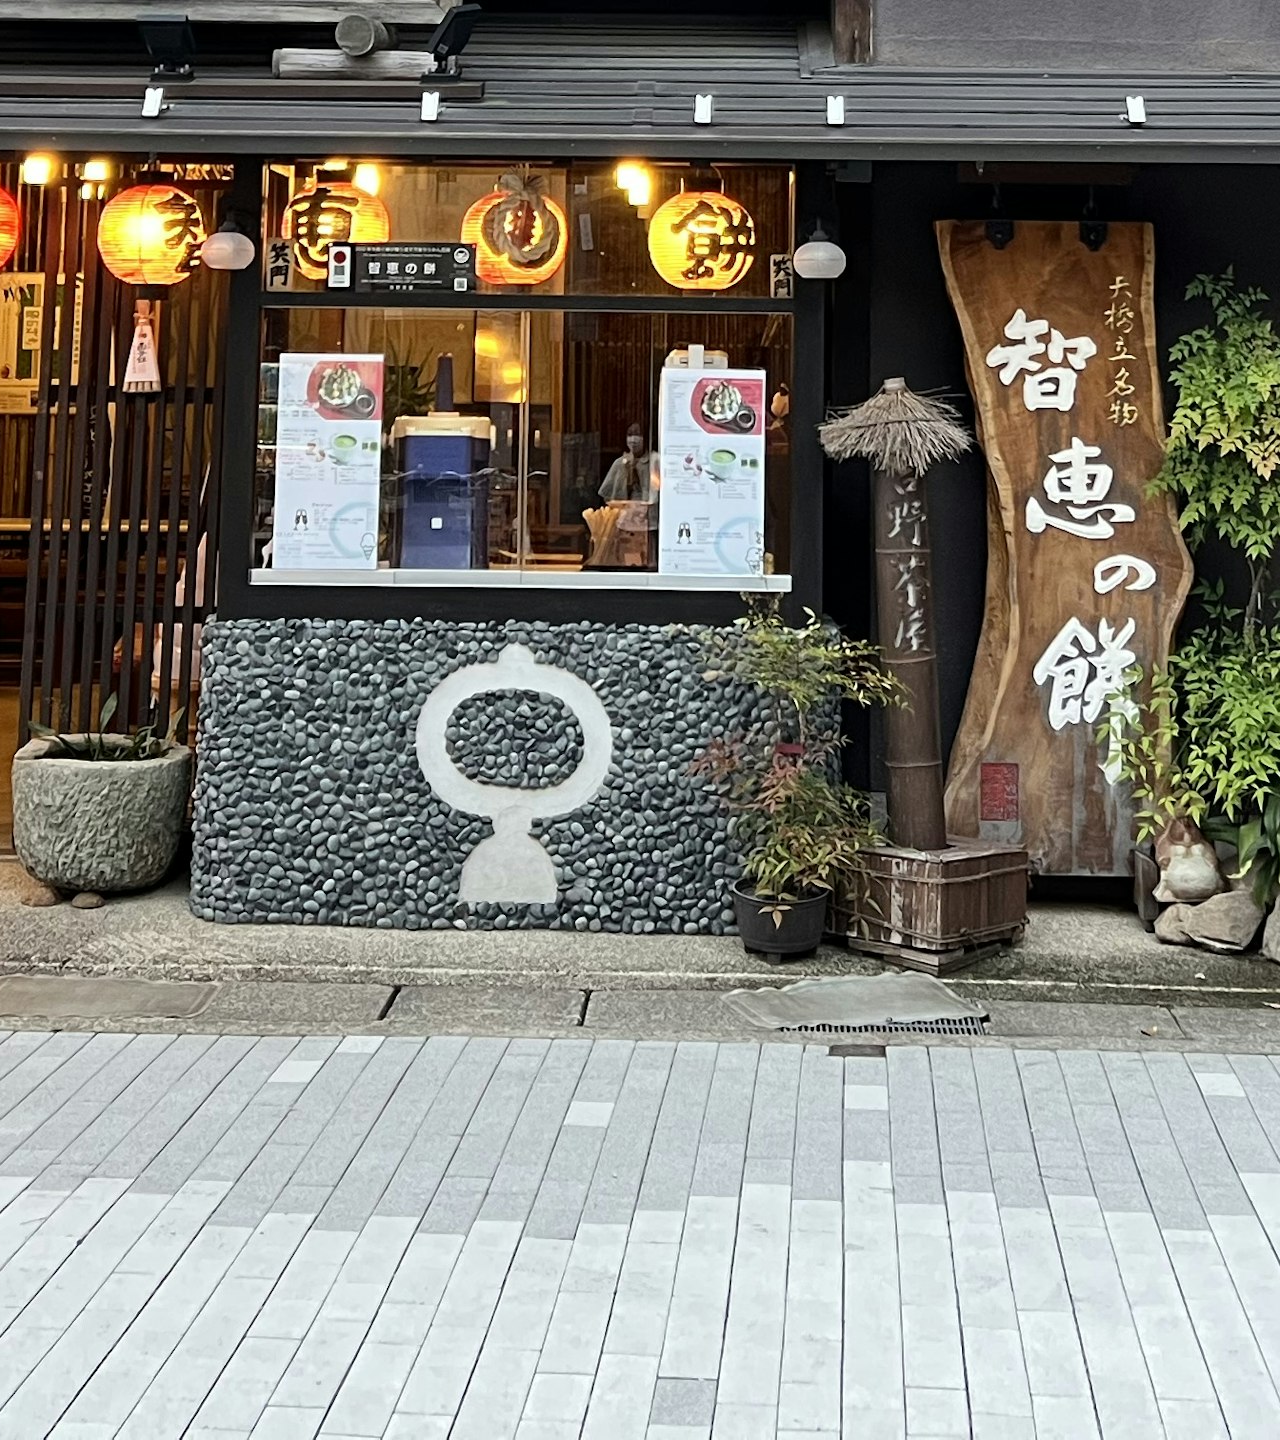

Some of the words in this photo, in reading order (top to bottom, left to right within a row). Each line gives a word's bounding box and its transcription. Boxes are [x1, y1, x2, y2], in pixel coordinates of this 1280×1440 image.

[270, 242, 289, 288] 笑門
[368, 261, 436, 276] 智恵の餅
[772, 255, 792, 298] 笑門
[1103, 275, 1139, 428] 天橋立名物
[986, 307, 1156, 787] 智恵の餅
